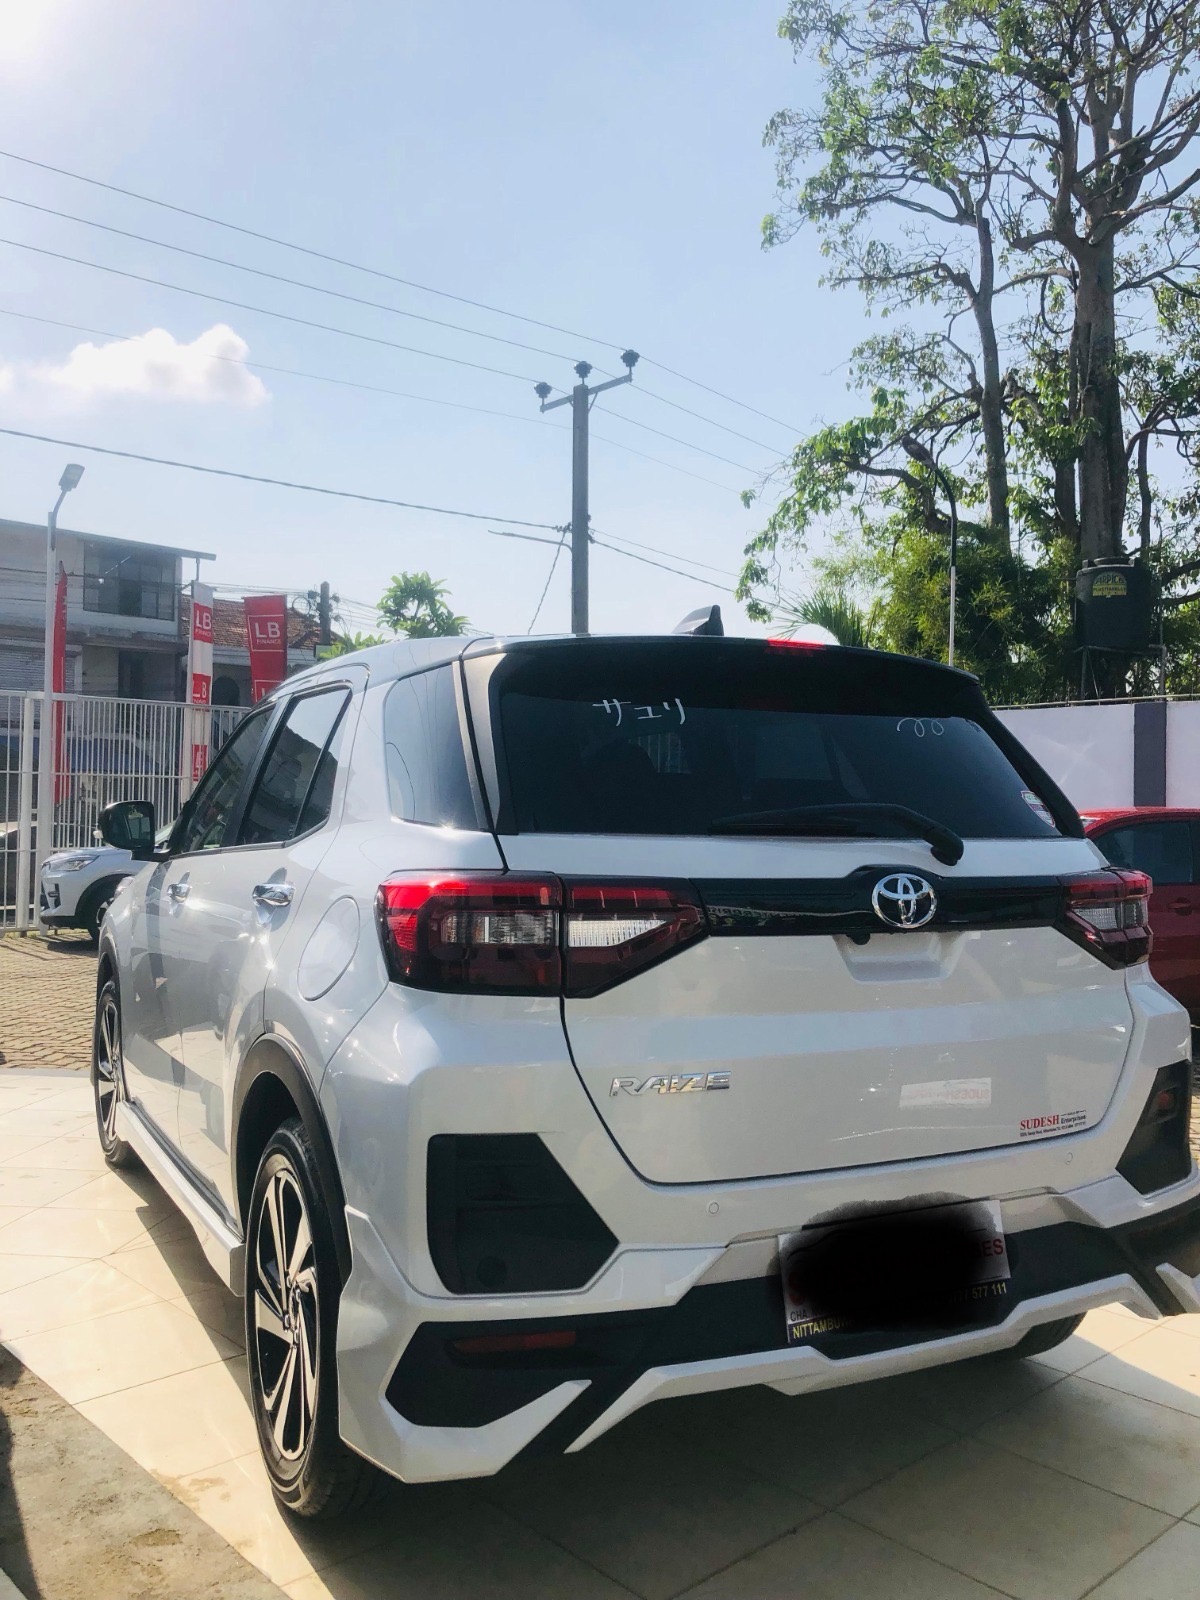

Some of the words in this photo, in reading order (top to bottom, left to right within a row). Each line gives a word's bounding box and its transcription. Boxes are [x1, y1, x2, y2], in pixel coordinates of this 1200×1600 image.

[195, 610, 212, 630] LB
[254, 622, 281, 638] LB
[609, 1071, 732, 1097] RAIZE
[1020, 1114, 1060, 1130] SUDESH
[991, 1281, 1007, 1294] 111
